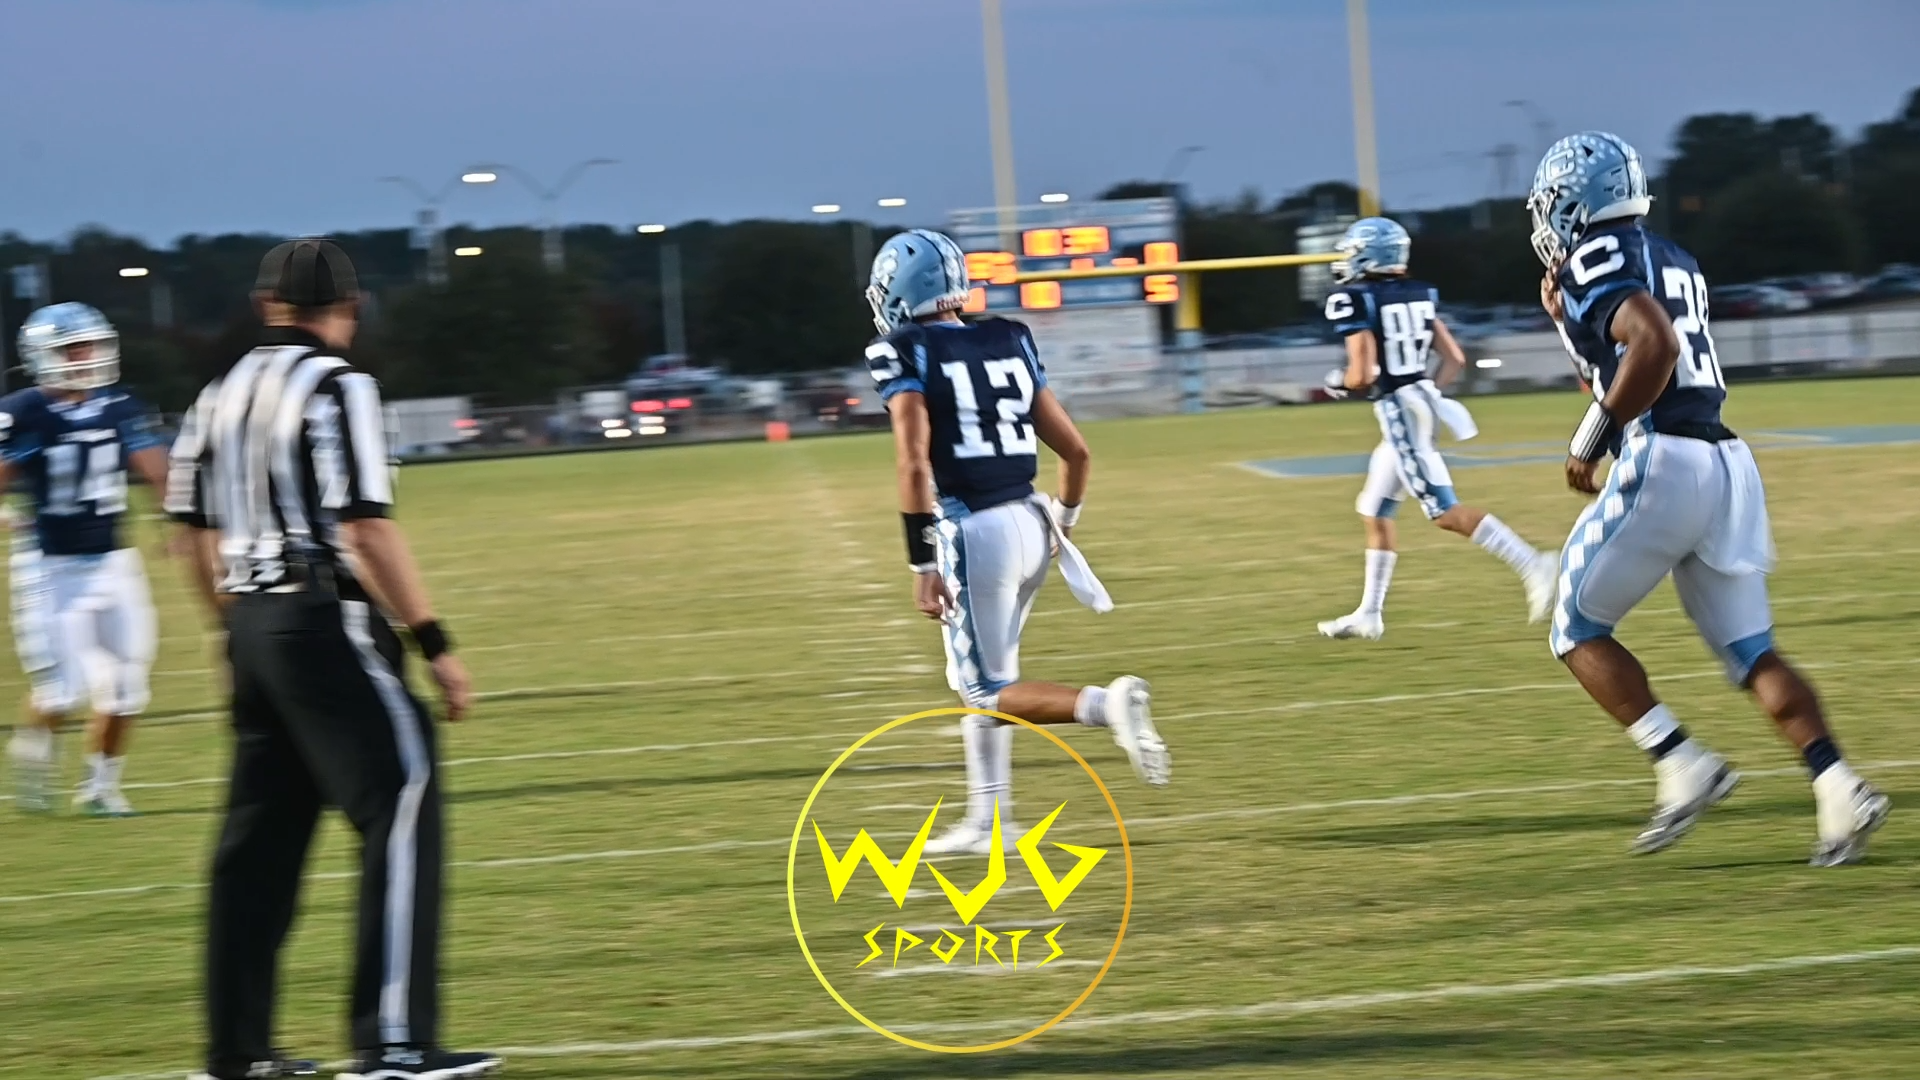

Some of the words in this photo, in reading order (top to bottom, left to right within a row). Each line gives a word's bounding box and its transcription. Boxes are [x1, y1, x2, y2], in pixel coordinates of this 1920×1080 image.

[1545, 148, 1576, 182] C
[1570, 234, 1626, 286] C
[1324, 292, 1354, 321] C
[940, 356, 1037, 460] 12
